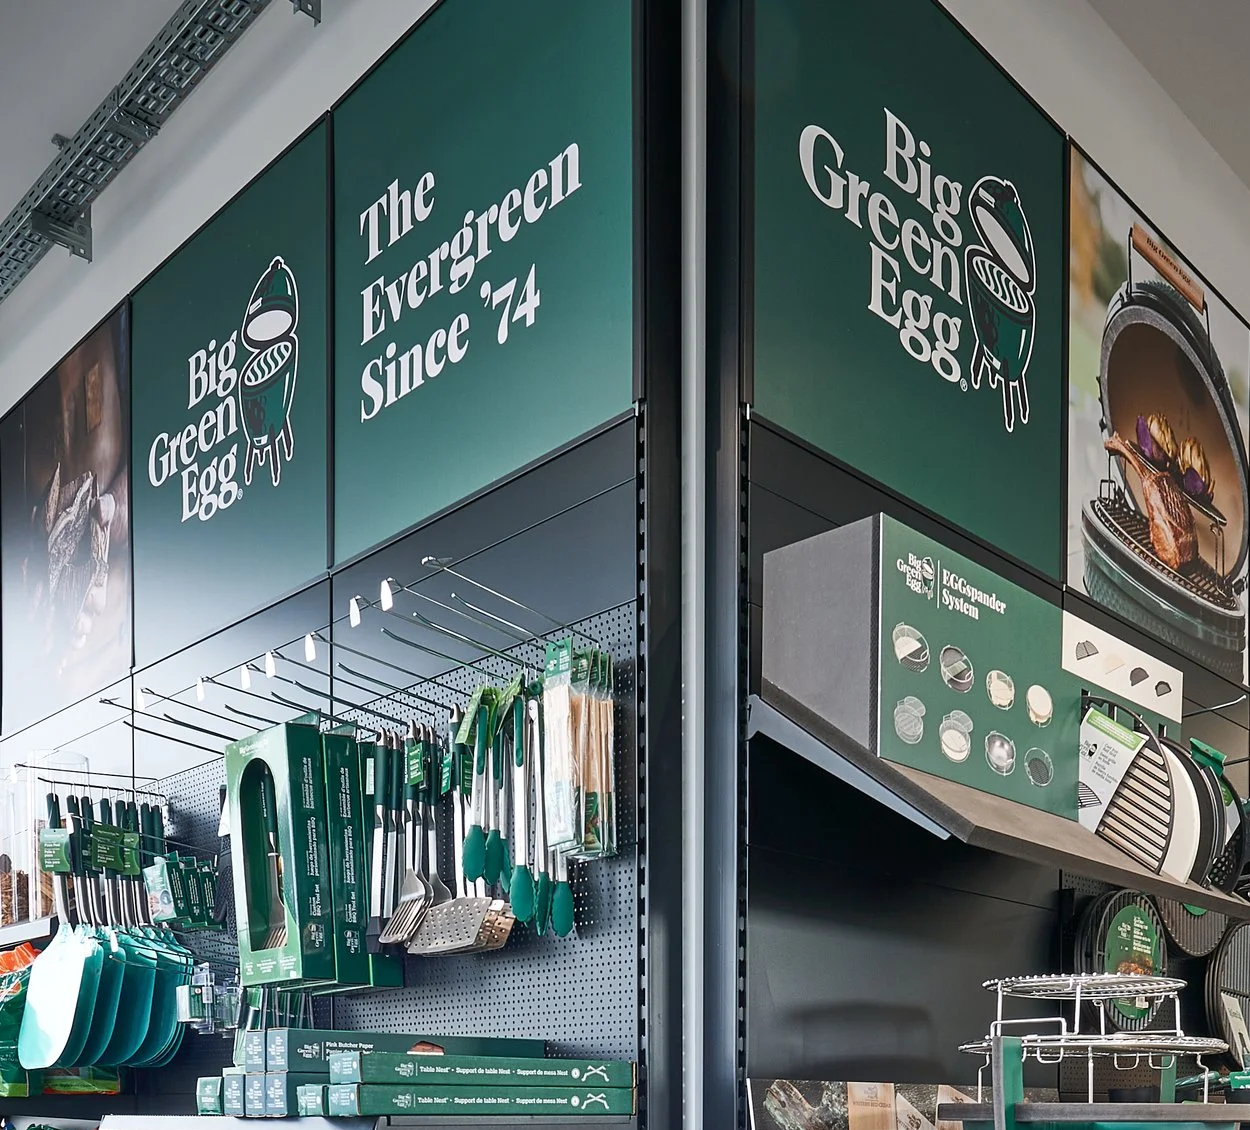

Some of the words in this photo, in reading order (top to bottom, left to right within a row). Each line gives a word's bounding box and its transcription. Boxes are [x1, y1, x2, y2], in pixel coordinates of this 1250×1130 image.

[360, 171, 435, 265] The
[799, 125, 963, 305] Green
[883, 107, 963, 247] Big
[360, 143, 582, 346] Evergreen
[360, 313, 470, 423] Since
[480, 263, 540, 344] ’74
[867, 241, 962, 382] Egg
[188, 330, 238, 410] Big
[149, 396, 238, 487] Green
[181, 443, 238, 523] Egg
[897, 559, 922, 580] Green
[906, 574, 922, 594] Egg
[908, 553, 922, 569] Big
[942, 569, 1007, 614] EGGspander
[942, 588, 979, 620] System
